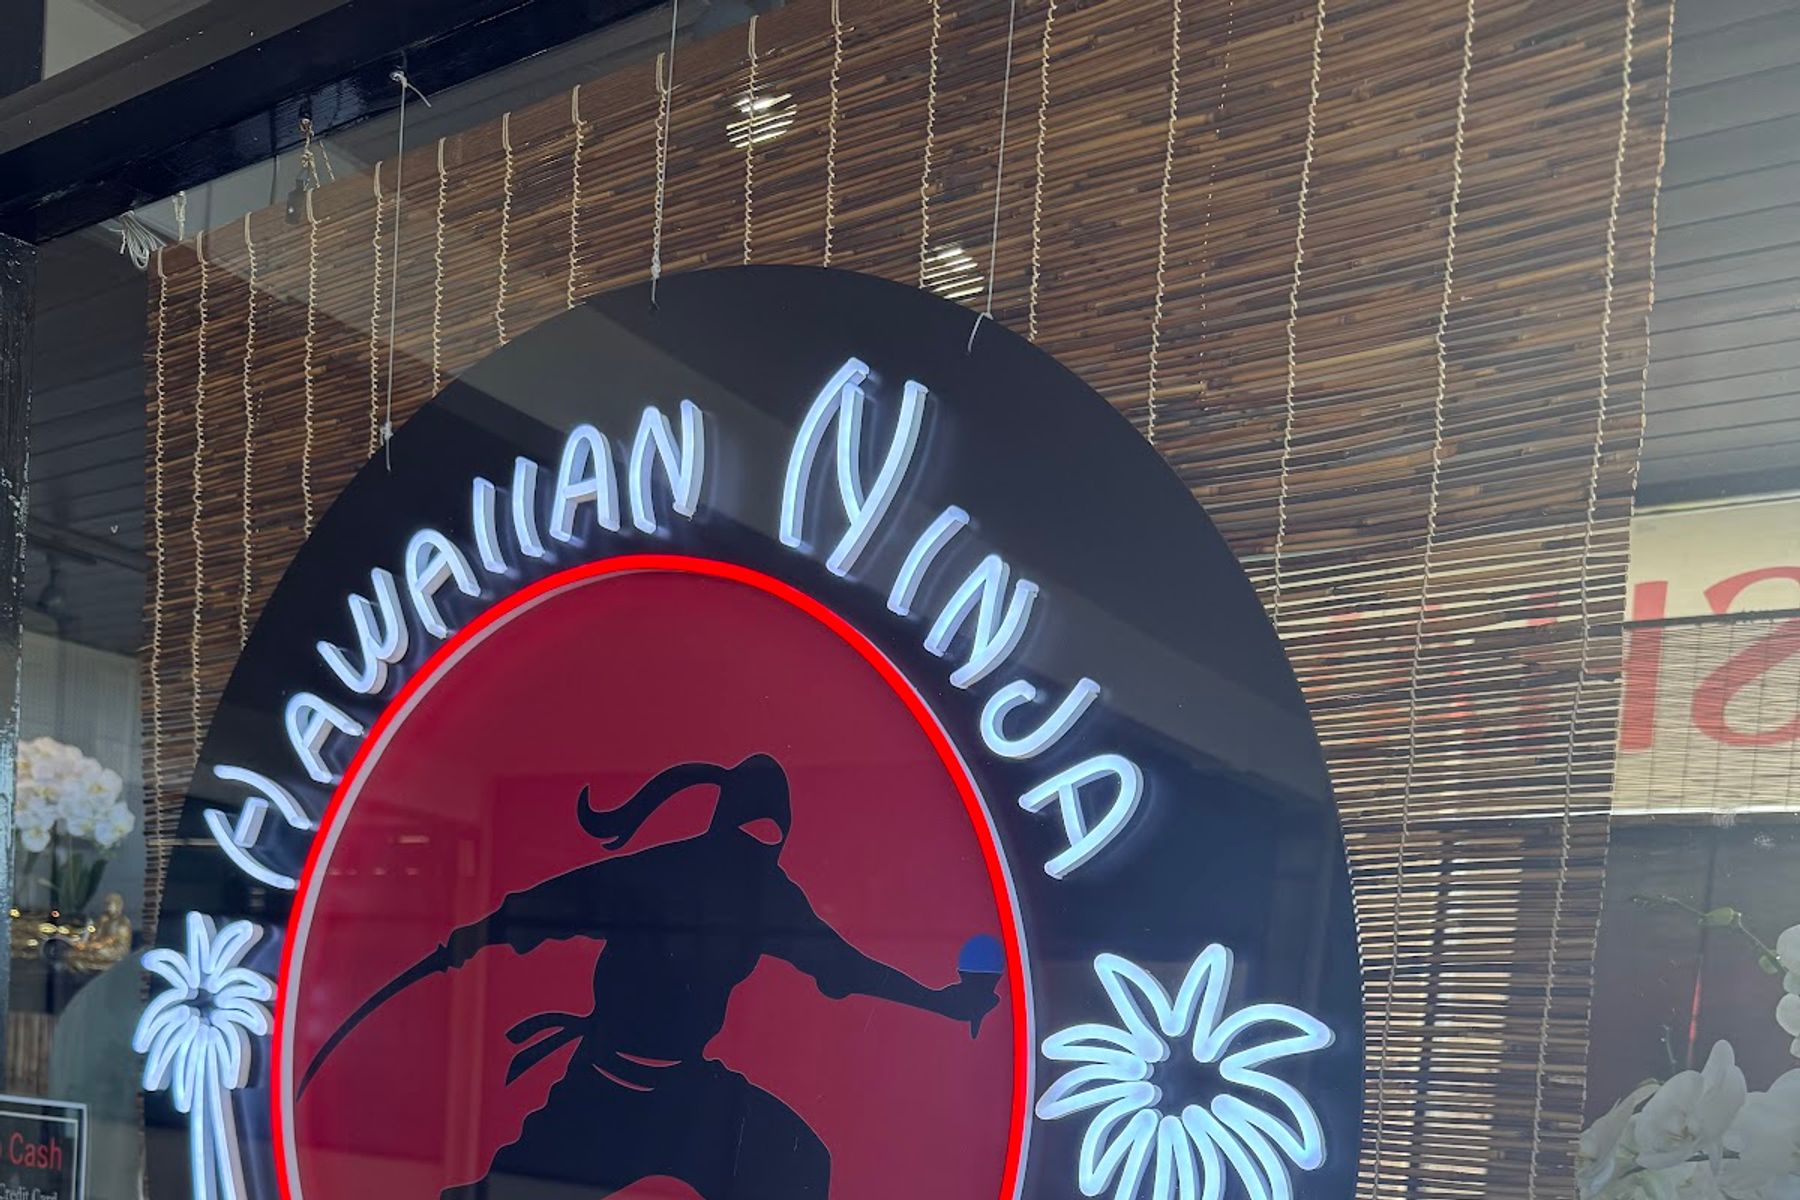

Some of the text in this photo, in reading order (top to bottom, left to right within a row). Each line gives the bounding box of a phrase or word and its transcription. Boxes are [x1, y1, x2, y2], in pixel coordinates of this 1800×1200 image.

[203, 357, 1144, 890] HAWAIIAN NINJA
[9, 1132, 62, 1171] Cash
